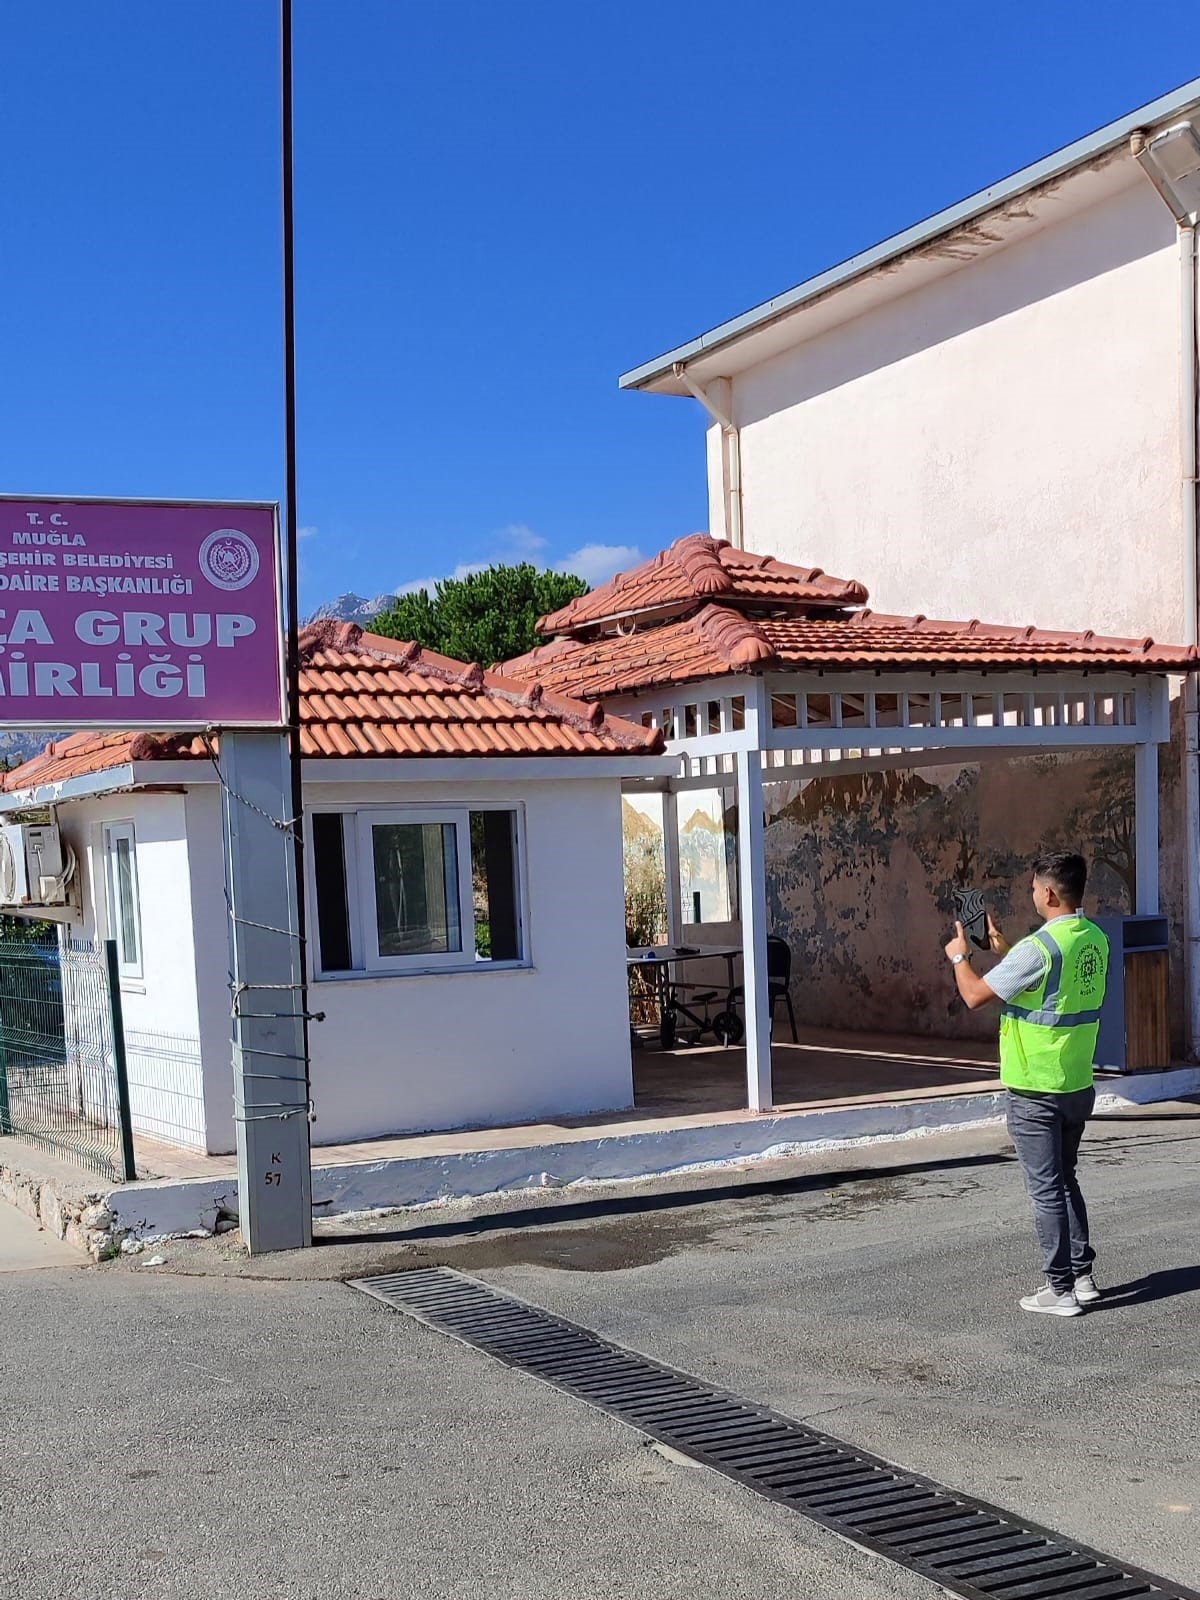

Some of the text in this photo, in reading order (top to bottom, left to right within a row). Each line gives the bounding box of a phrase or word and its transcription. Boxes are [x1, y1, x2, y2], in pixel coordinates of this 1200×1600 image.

[26, 512, 69, 526] T. C.
[12, 529, 87, 547] MUĞLA
[0, 549, 174, 569] ŞEHİR BELEDİYESİ
[0, 570, 193, 598] DAİRE BAŞKANLIĞI
[0, 609, 257, 653] A GRUP
[0, 650, 206, 698] İRLİĞİ
[271, 1151, 282, 1164] K
[264, 1171, 281, 1187] 57
